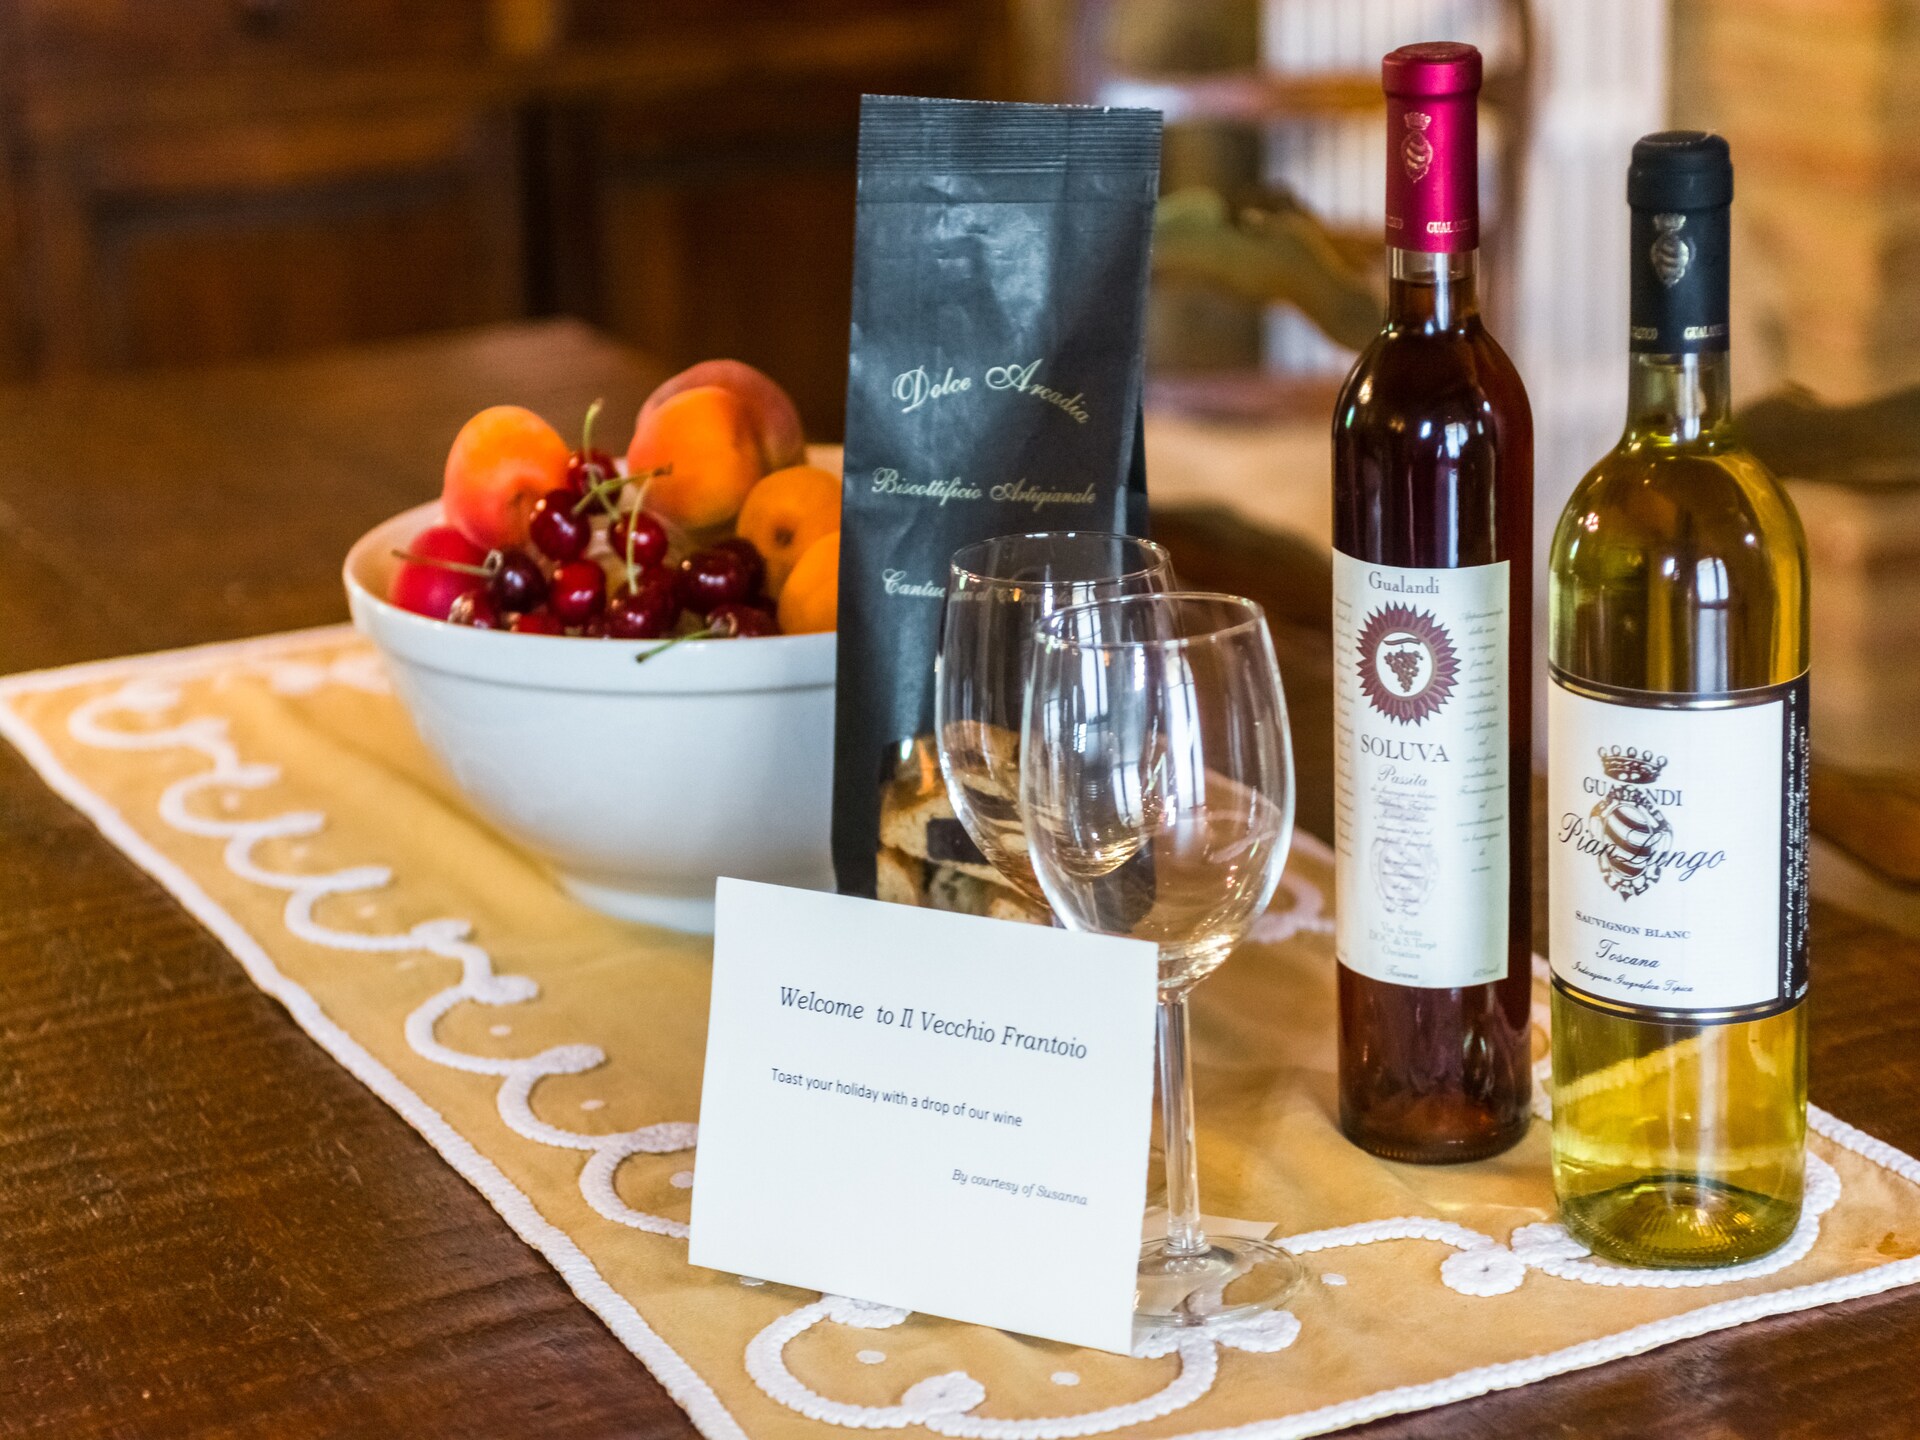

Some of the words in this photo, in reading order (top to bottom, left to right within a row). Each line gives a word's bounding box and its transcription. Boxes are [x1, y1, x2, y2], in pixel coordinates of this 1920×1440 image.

[892, 364, 972, 413] Dolce
[985, 358, 1091, 424] Arcadia
[871, 467, 983, 507] Biscottificio
[989, 478, 1096, 512] Artigianale
[1368, 570, 1440, 594] Gualandi
[1360, 733, 1450, 763] SOLUVA
[1558, 812, 1620, 859] Pian
[1617, 828, 1726, 882] Lungo
[1575, 910, 1641, 935] SAUVIGNON
[1644, 927, 1692, 940] BLANC
[1595, 938, 1661, 969] Toscana
[780, 986, 865, 1020] Welcome
[876, 1004, 895, 1025] to
[921, 1011, 996, 1043] Vecchio
[1000, 1025, 1088, 1060] Frantoio
[772, 1068, 804, 1087] Toast
[805, 1075, 834, 1091] your
[836, 1079, 879, 1103] holiday
[882, 1090, 909, 1107] with
[911, 1097, 919, 1108] a
[921, 1096, 950, 1116] drop
[952, 1102, 966, 1117] of
[968, 1106, 990, 1120] our
[992, 1110, 1023, 1127] wine
[952, 1169, 968, 1185] By
[970, 1174, 1019, 1195] courtesy
[1021, 1182, 1036, 1199] of
[1036, 1185, 1089, 1206] Susanna
